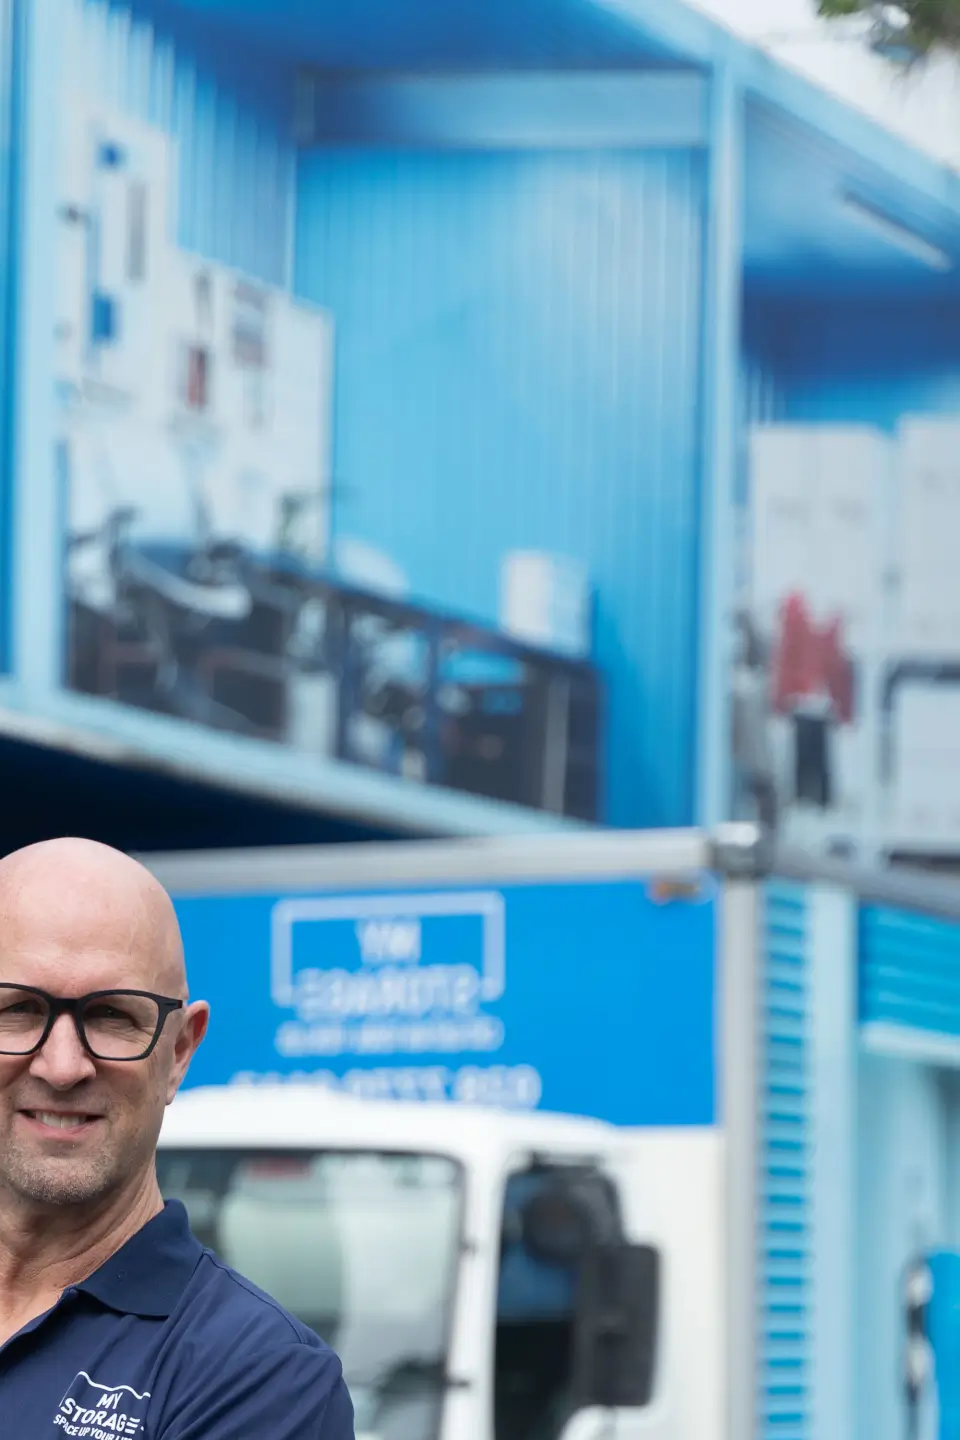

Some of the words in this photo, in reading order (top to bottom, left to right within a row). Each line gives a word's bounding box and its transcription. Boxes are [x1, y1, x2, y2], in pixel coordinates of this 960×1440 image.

[96, 1392, 123, 1409] MY
[53, 1414, 80, 1436] SPACE
[79, 1426, 90, 1436] UP
[61, 1398, 140, 1434] STORAGE
